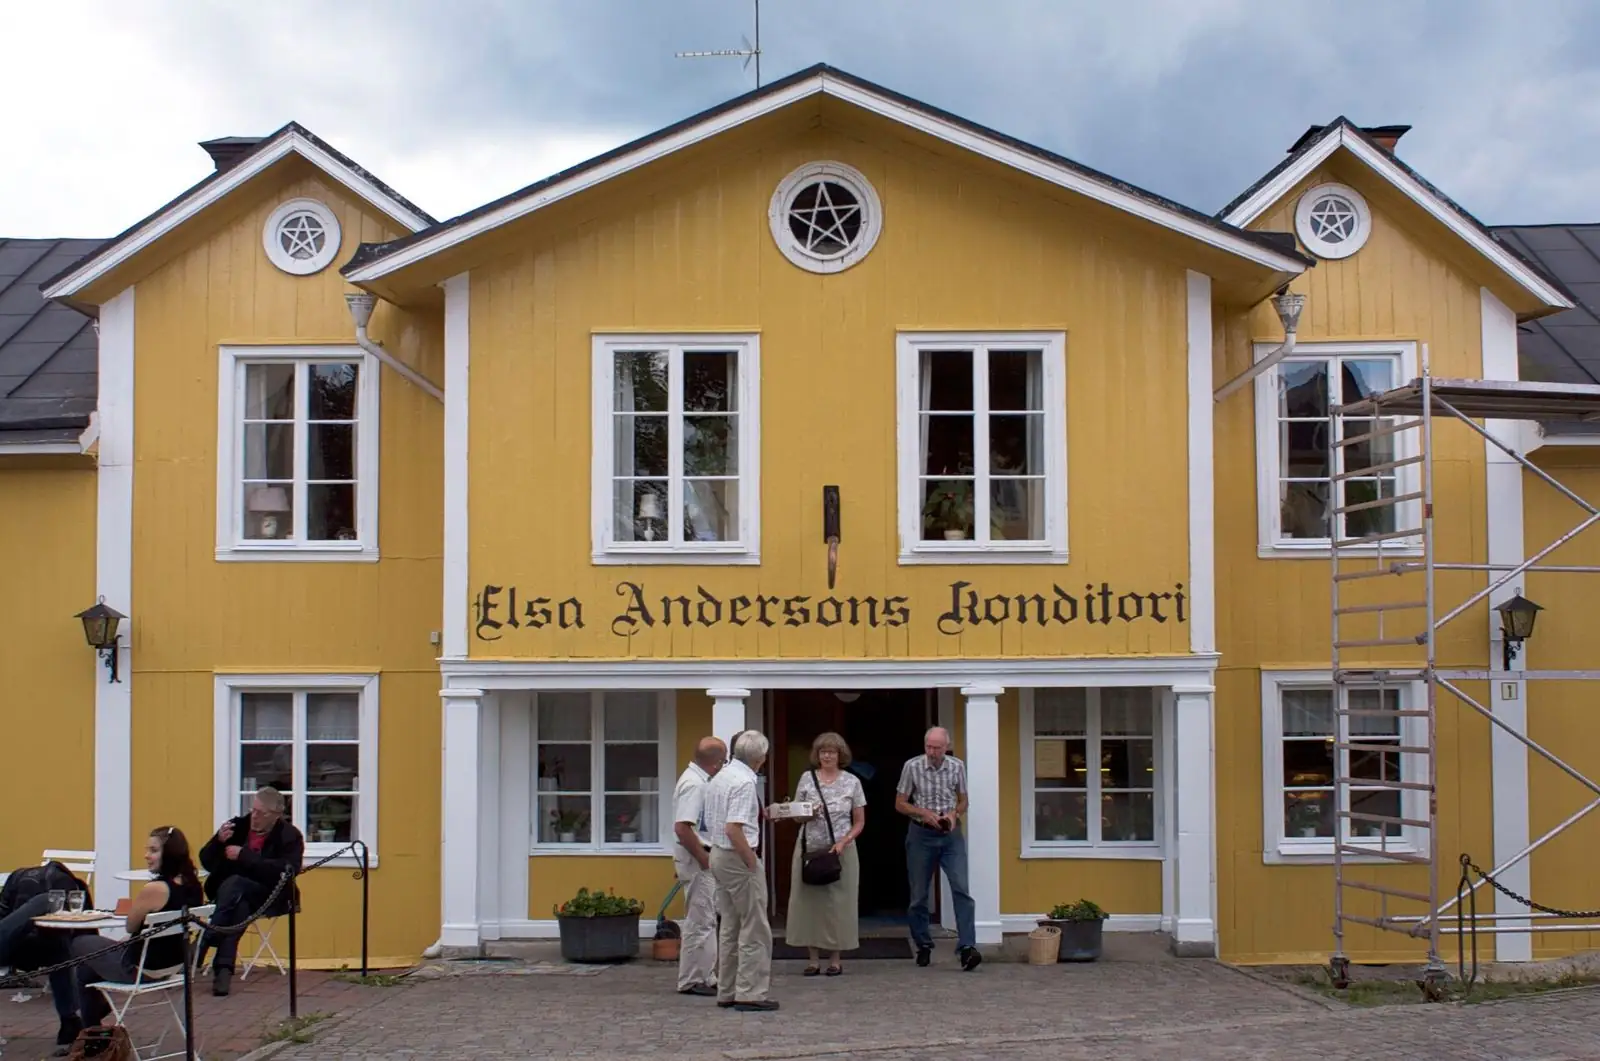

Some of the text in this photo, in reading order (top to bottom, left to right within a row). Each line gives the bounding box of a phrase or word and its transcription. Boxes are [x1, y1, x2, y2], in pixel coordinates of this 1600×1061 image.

[473, 581, 1187, 641] Elsa Andersons Konditori
